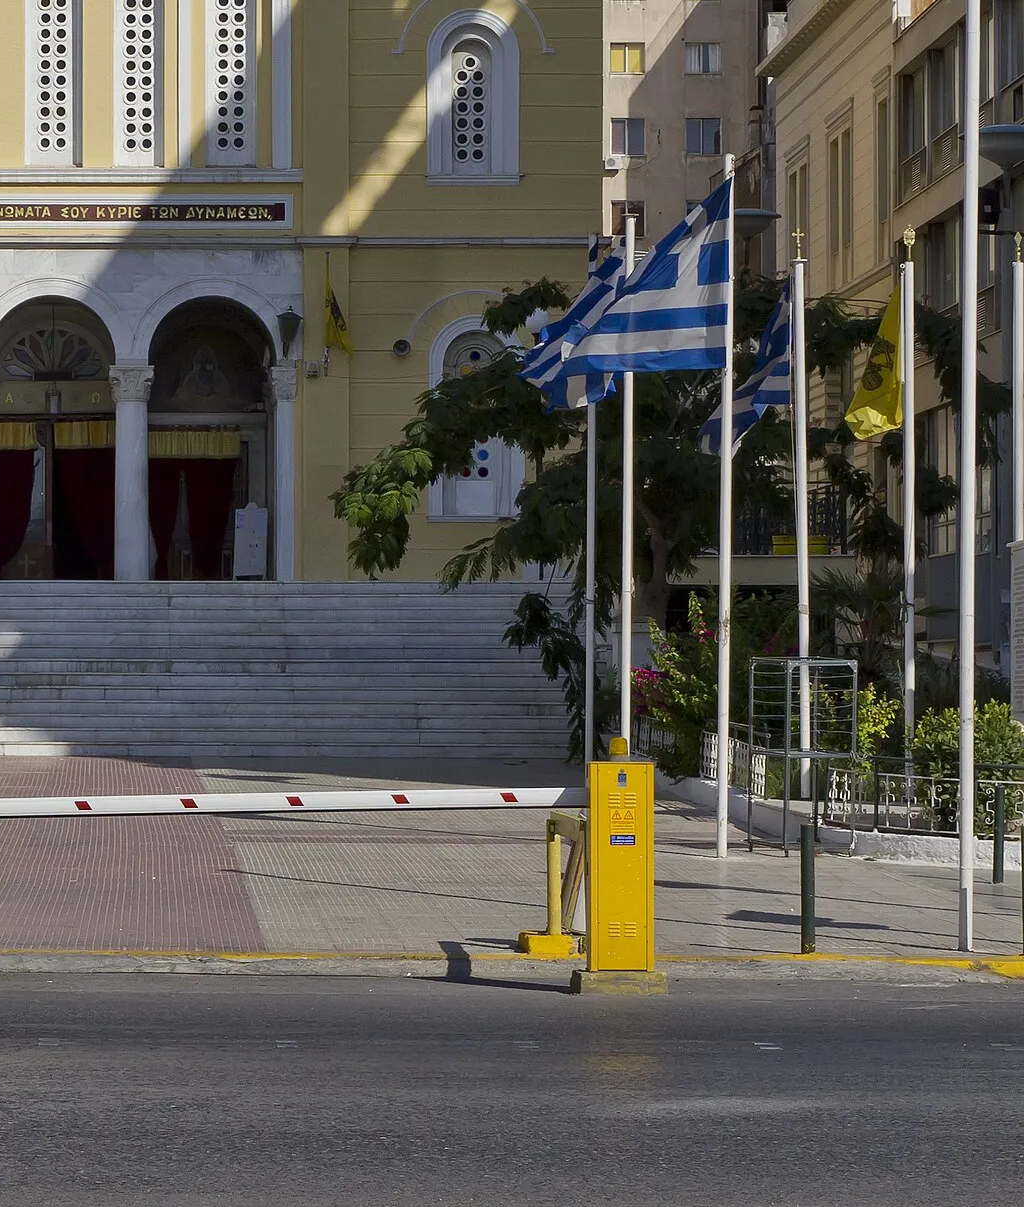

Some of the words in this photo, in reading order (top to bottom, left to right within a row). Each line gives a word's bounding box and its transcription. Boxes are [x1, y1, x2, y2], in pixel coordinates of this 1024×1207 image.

[60, 206, 89, 219] ΣΟΥ
[96, 206, 142, 219] ΚΥΡΙΕ
[150, 206, 179, 219] ΤΩΝ
[91, 392, 101, 404] Ω
